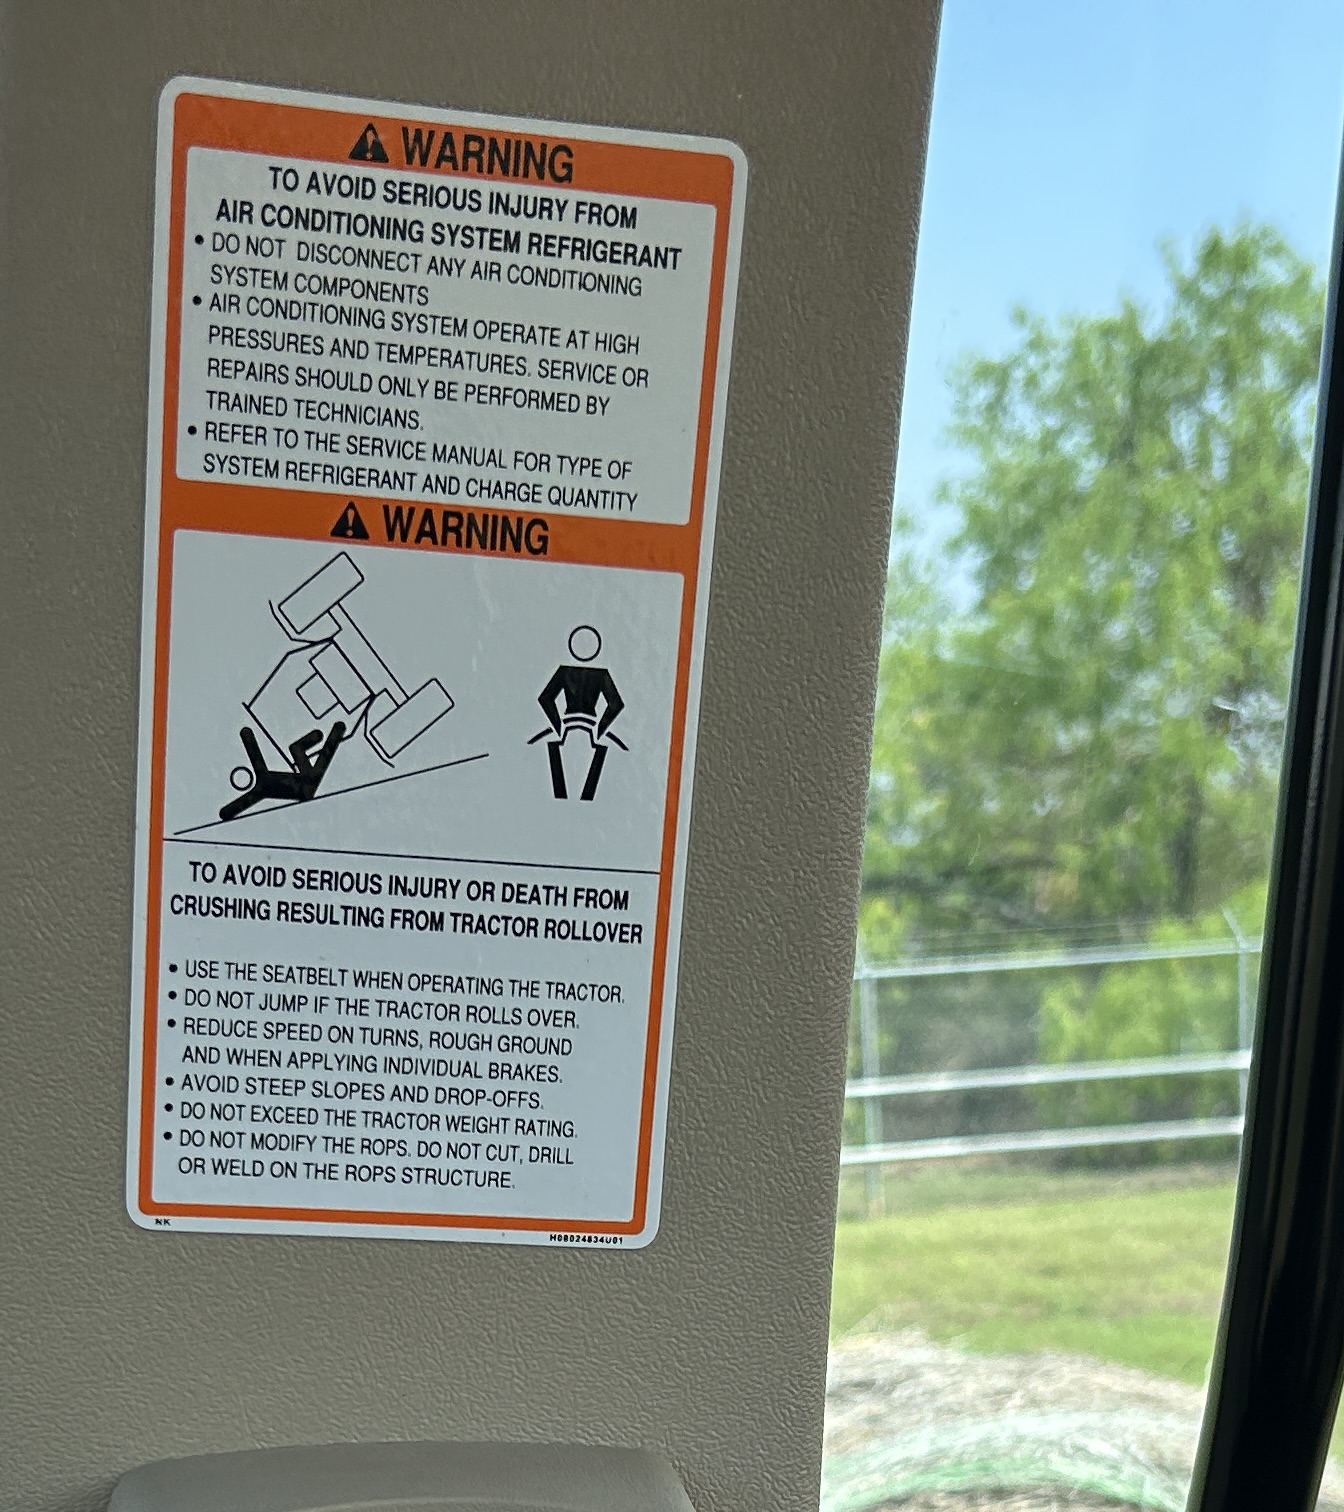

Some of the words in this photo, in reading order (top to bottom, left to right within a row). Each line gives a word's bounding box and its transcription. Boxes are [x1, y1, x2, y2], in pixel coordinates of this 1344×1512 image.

[402, 126, 573, 184] WARNING
[267, 164, 301, 194] TO
[304, 169, 378, 202] AVOID
[381, 178, 484, 215] SERIOUS
[487, 190, 570, 223] INJURY
[573, 199, 639, 231] FROM
[214, 197, 255, 226] AIR
[259, 202, 426, 245] CONDITIONING
[429, 220, 523, 256] SYSTEM
[526, 230, 684, 272] REFRIGERANT
[209, 262, 290, 293] SYSTEM
[292, 271, 430, 308] COMPONENTS
[211, 230, 242, 256] DO
[244, 233, 288, 260] NOT
[295, 239, 424, 275] DISCONNECT
[425, 254, 468, 279] ANY
[469, 259, 503, 284] AIR
[505, 262, 643, 298] CONDITIONING
[207, 290, 242, 316] AIR
[244, 294, 387, 332] CONDITIONING
[389, 309, 469, 340] SYSTEM
[471, 318, 563, 349] OPERATE
[564, 328, 591, 351] AT
[593, 330, 641, 357] HIGH
[207, 323, 326, 358] PRESSURES
[328, 336, 371, 361] AND
[373, 340, 533, 379] TEMPERATURES.
[536, 357, 619, 387] SERVICE
[620, 365, 650, 390] OR
[204, 388, 289, 419] TRAINED
[291, 396, 425, 432] TECHNICIANS.
[206, 356, 291, 387] REPAIRS
[293, 364, 374, 395] SHOULD
[376, 373, 431, 400] ONLY
[432, 379, 460, 403] BE
[463, 381, 582, 415] PERFORMED
[584, 393, 612, 418] BY
[204, 419, 269, 448] REFER
[271, 426, 300, 451] TO
[302, 428, 342, 455] THE
[344, 433, 428, 463] SERVICE
[431, 441, 509, 471] MANUAL
[512, 449, 553, 475] FOR
[555, 453, 604, 480] TYPE
[606, 458, 634, 482] OF
[201, 451, 281, 481] SYSTEM
[284, 459, 420, 493] REFRIGERANT
[420, 472, 462, 497] AND
[464, 476, 545, 505] CHARGE
[546, 484, 639, 513] QUANTITY
[383, 504, 549, 556] WARNING
[187, 859, 219, 885] TO
[221, 862, 288, 889] AVOID
[290, 866, 384, 897] SERIOUS
[386, 873, 463, 901] INJURY
[465, 878, 497, 904] OR
[500, 881, 569, 909] DEATH
[571, 886, 631, 912] FROM
[169, 892, 273, 922] CRUSHING
[275, 899, 386, 930] RESULTING
[389, 906, 446, 934] FROM
[448, 910, 541, 940] TRACTOR
[542, 916, 644, 946] ROLLOVER
[184, 958, 221, 981] USE
[222, 960, 259, 983] THE
[261, 963, 350, 989] SEATBELT
[351, 968, 405, 992] WHEN
[406, 972, 505, 998] OPERATING
[507, 977, 542, 1000] THE
[544, 979, 626, 1005] TRACTOR.
[183, 986, 213, 1009] DO
[215, 988, 257, 1011] NOT
[257, 991, 310, 1014] JUMP
[312, 994, 332, 1016] IF
[333, 995, 372, 1019] THE
[373, 997, 462, 1024] TRACTOR
[464, 1003, 524, 1028] ROLLS
[525, 1007, 581, 1030] OVER.
[182, 1015, 259, 1040] REDUCE
[261, 1019, 324, 1044] SPEED
[326, 1023, 356, 1046] ON
[357, 1025, 425, 1053] TURNS,
[427, 1029, 494, 1053] ROUGH
[496, 1032, 574, 1057] GROUND
[180, 1044, 222, 1066] AND
[224, 1045, 283, 1070] WHEN
[285, 1049, 379, 1075] APPLYING
[382, 1054, 485, 1081] INDIVIDUAL
[486, 1060, 564, 1085] BRAKES.
[180, 1072, 241, 1095] AVOID
[243, 1074, 308, 1099] STEEP
[309, 1078, 387, 1103] SLOPES
[388, 1082, 430, 1105] AND
[433, 1085, 545, 1111] DROP-OFFS.
[179, 1100, 207, 1121] DO
[208, 1101, 248, 1123] NOT
[249, 1103, 320, 1127] EXCEED
[321, 1107, 358, 1129] THE
[359, 1109, 442, 1133] TRACTOR
[444, 1113, 512, 1136] WEIGHT
[513, 1116, 579, 1140] RATING.
[177, 1155, 207, 1176] OR
[209, 1156, 266, 1179] WELD
[268, 1159, 299, 1180] ON
[301, 1161, 341, 1182] THE
[343, 1162, 398, 1185] ROPS
[399, 1165, 517, 1190] STRUCTURE.
[178, 1127, 207, 1149] DO
[208, 1129, 248, 1151] NOT
[249, 1131, 319, 1154] MODIFY
[320, 1134, 357, 1156] THE
[359, 1136, 413, 1160] ROPS.
[416, 1138, 444, 1160] DO
[445, 1139, 484, 1162] NOT
[484, 1142, 524, 1167] CUT,
[527, 1144, 575, 1166] DRILL
